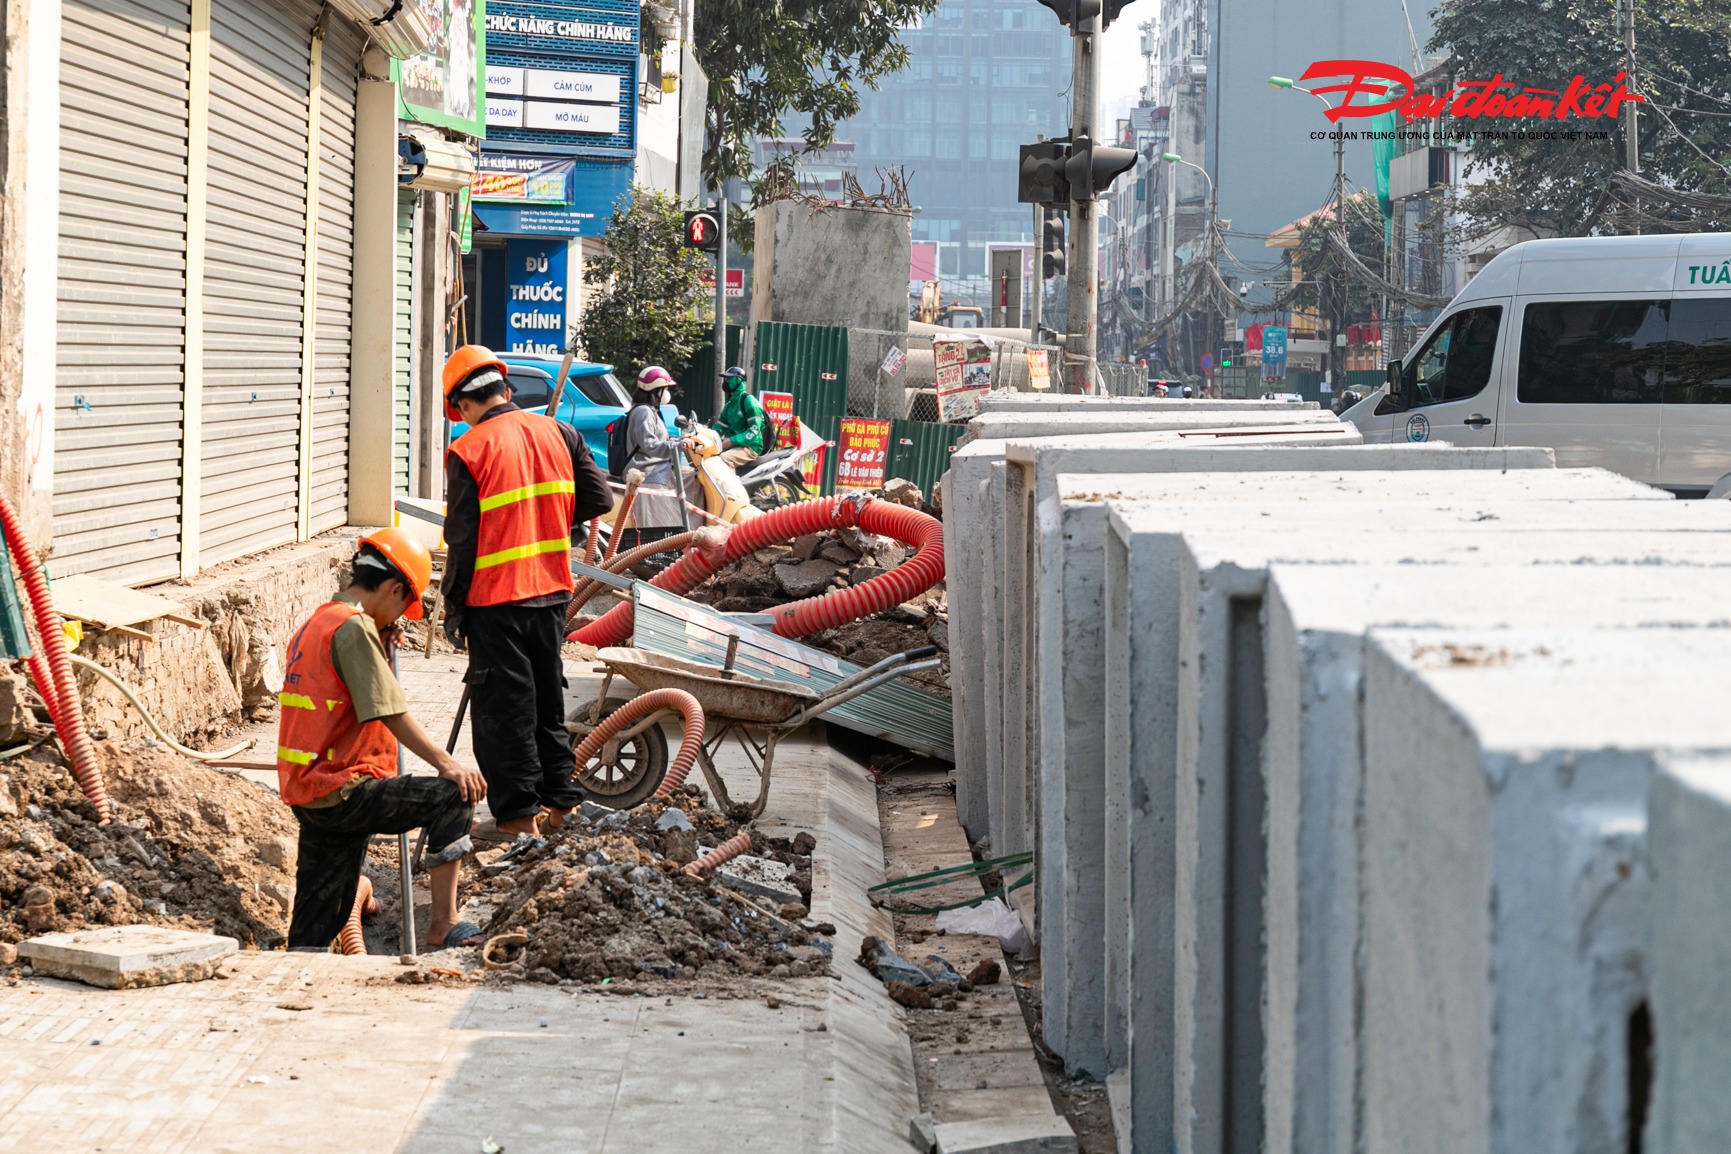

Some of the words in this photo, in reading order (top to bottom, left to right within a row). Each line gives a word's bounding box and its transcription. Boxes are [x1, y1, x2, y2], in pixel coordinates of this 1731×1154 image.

[485, 12, 516, 31] CHỨC
[519, 15, 553, 35] NĂNG
[557, 18, 596, 38] CHÍNH
[597, 21, 631, 41] HÃNG
[490, 155, 517, 171] KIỆM
[525, 252, 548, 273] ĐỦ
[509, 280, 563, 302] THUỐC
[510, 308, 561, 330] CHÍNH
[512, 339, 558, 355] HÃNG
[843, 448, 860, 462] Cơ
[860, 449, 875, 462] sở
[875, 450, 885, 462] 2
